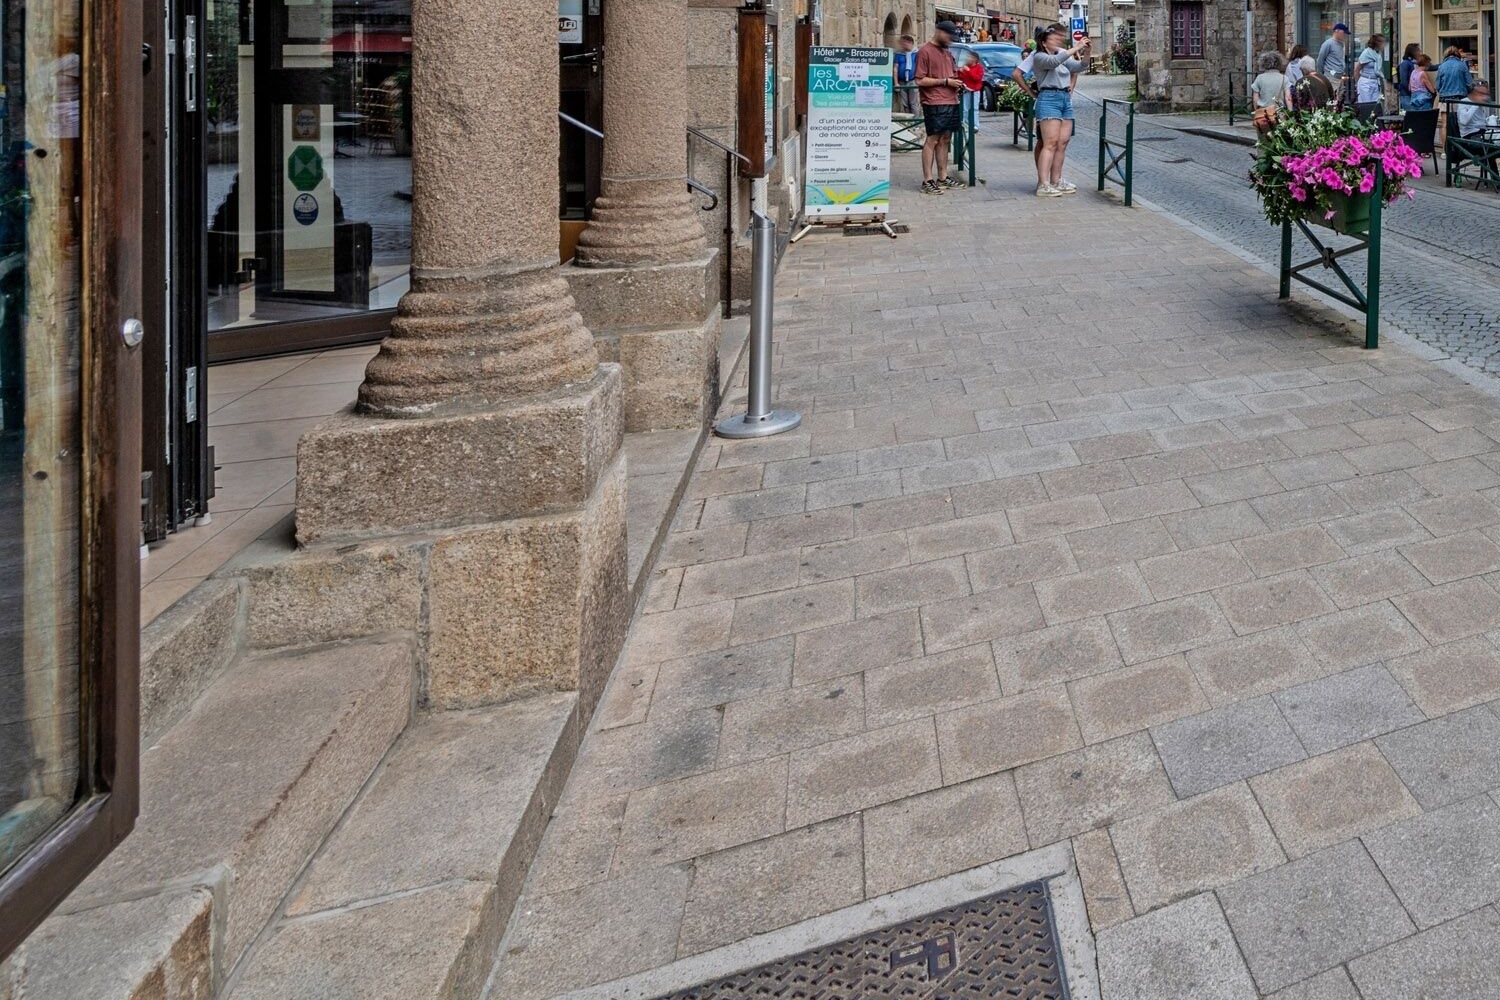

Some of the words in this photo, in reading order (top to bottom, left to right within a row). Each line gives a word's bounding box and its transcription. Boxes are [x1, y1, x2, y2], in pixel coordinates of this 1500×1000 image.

[850, 48, 888, 58] Brasserie
[813, 67, 833, 79] les
[812, 79, 888, 92] ARCADES
[836, 118, 855, 126] point
[809, 125, 857, 133] exceptionnel
